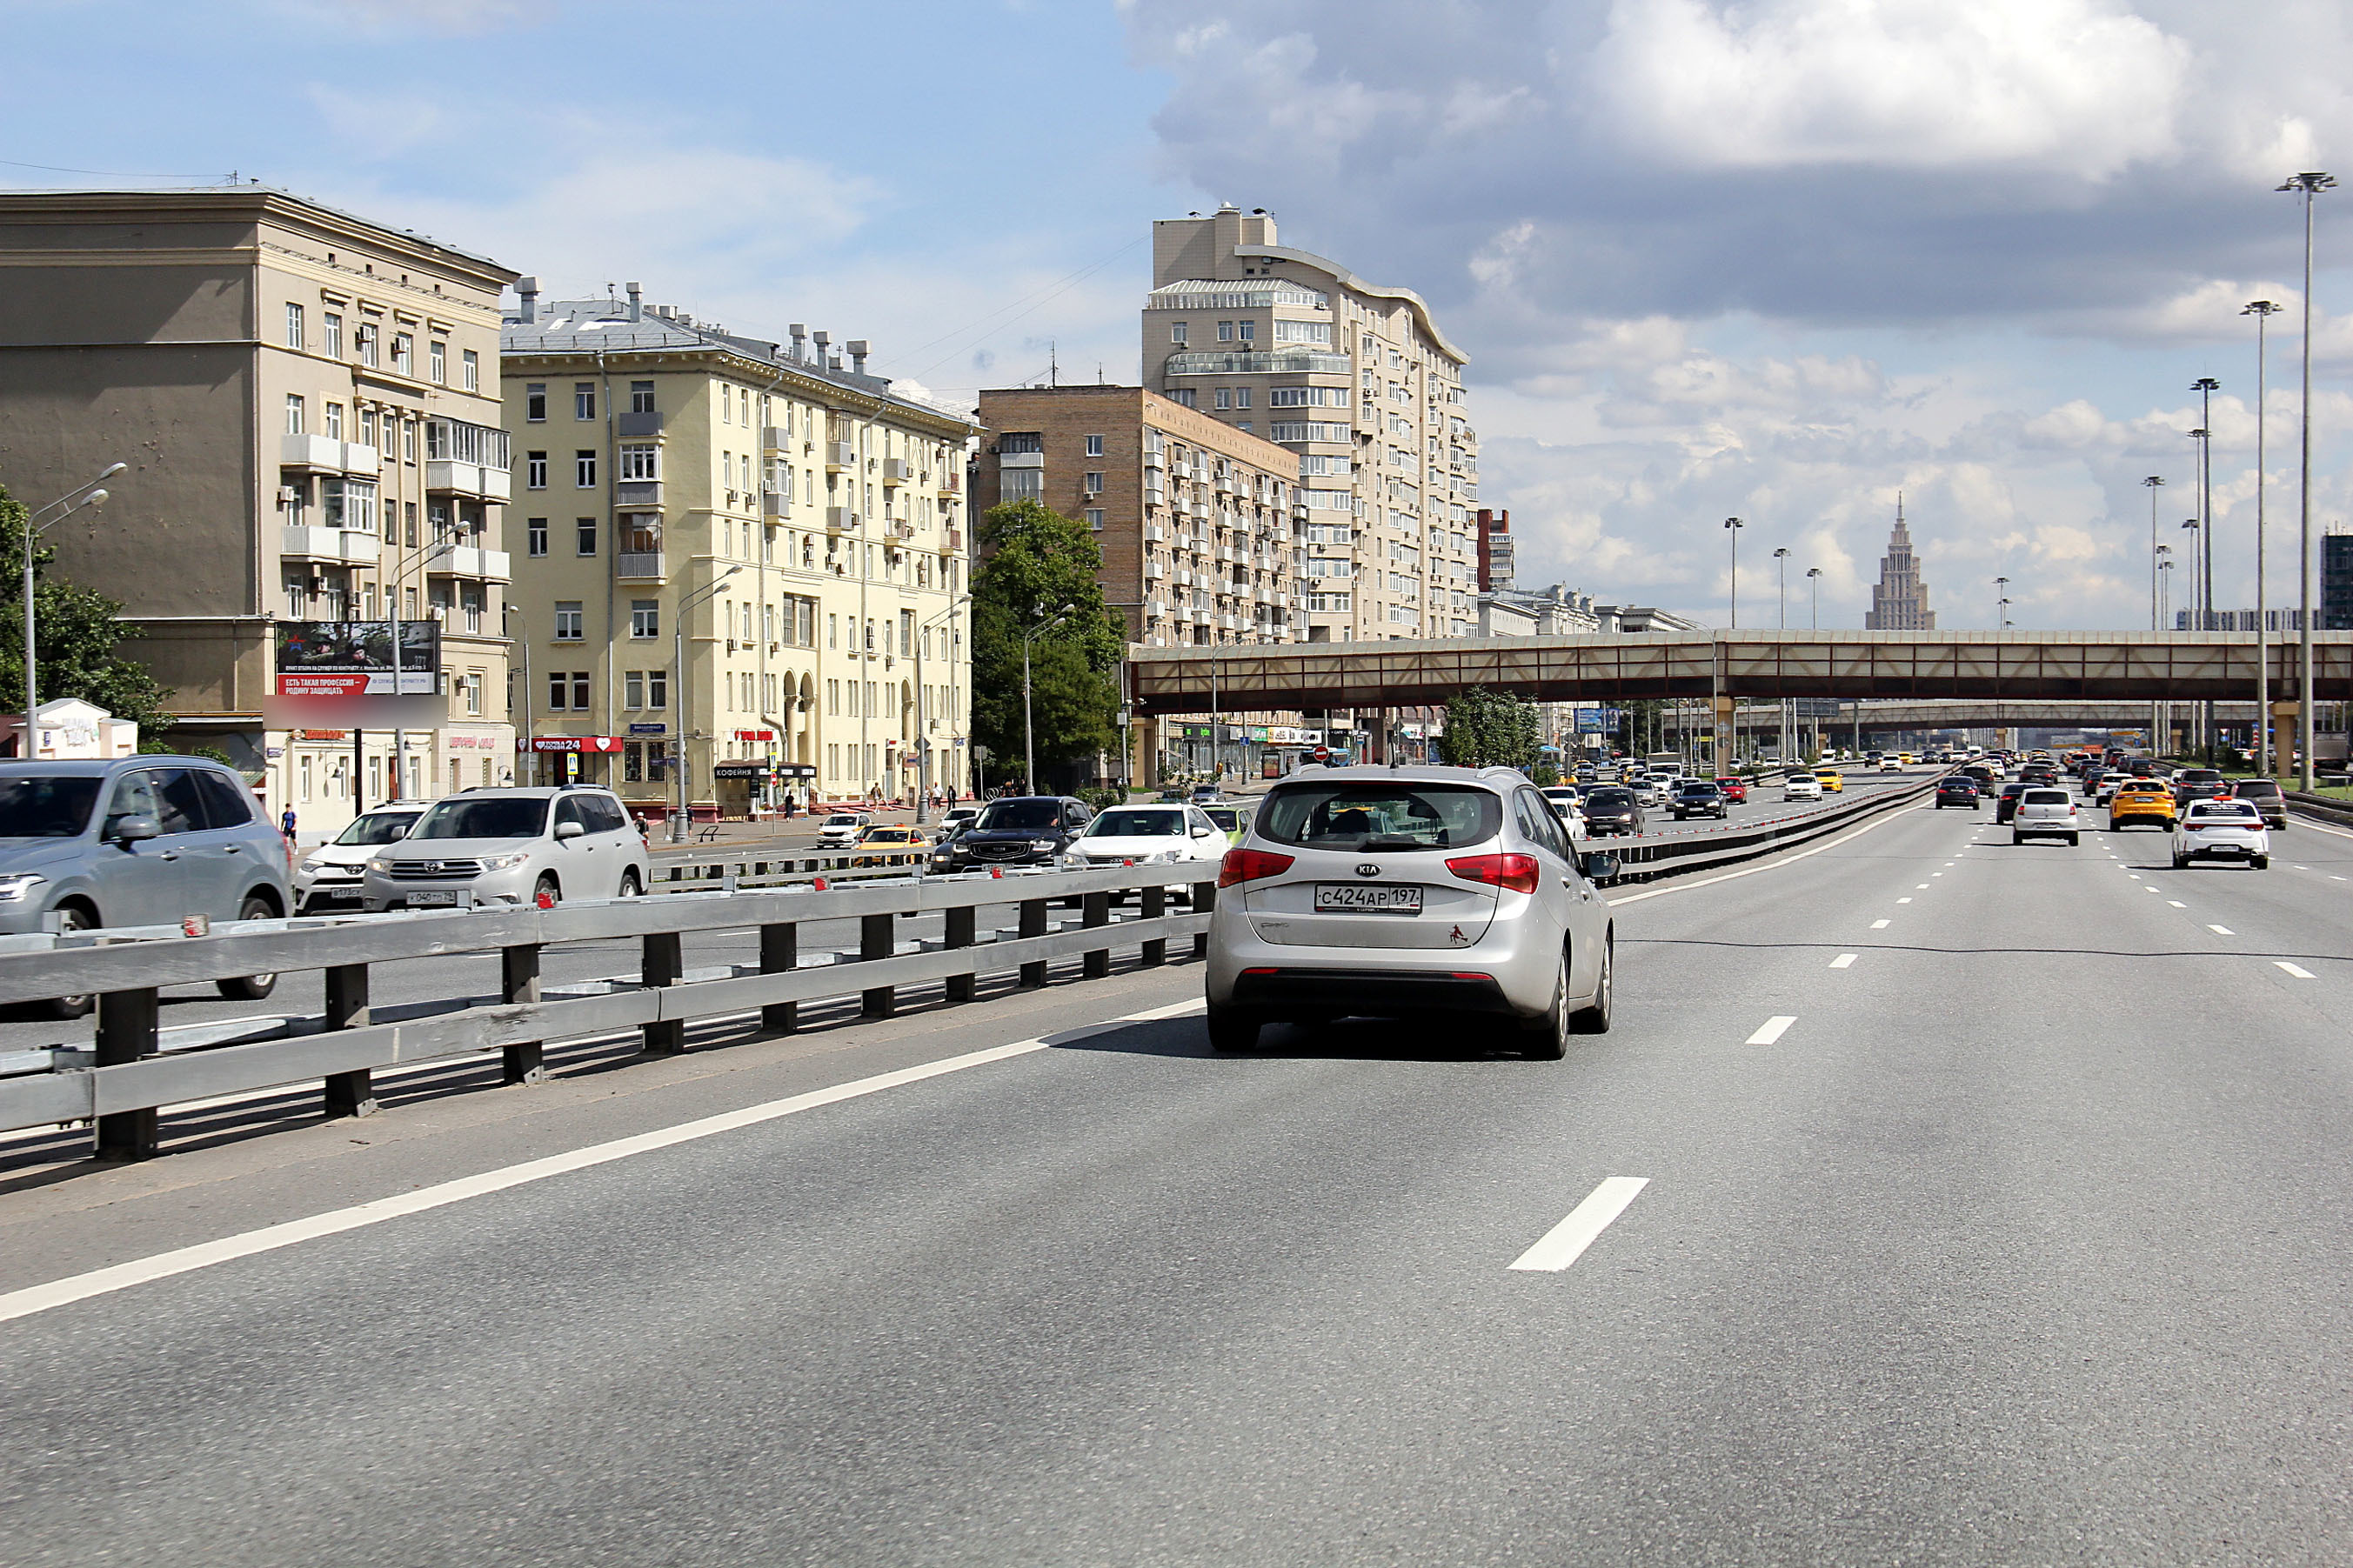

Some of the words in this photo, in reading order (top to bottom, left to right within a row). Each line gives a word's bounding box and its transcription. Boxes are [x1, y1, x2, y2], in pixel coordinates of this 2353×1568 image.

[565, 740, 581, 750] 24
[1321, 888, 1387, 905] С424АР
[1392, 889, 1417, 902] 197
